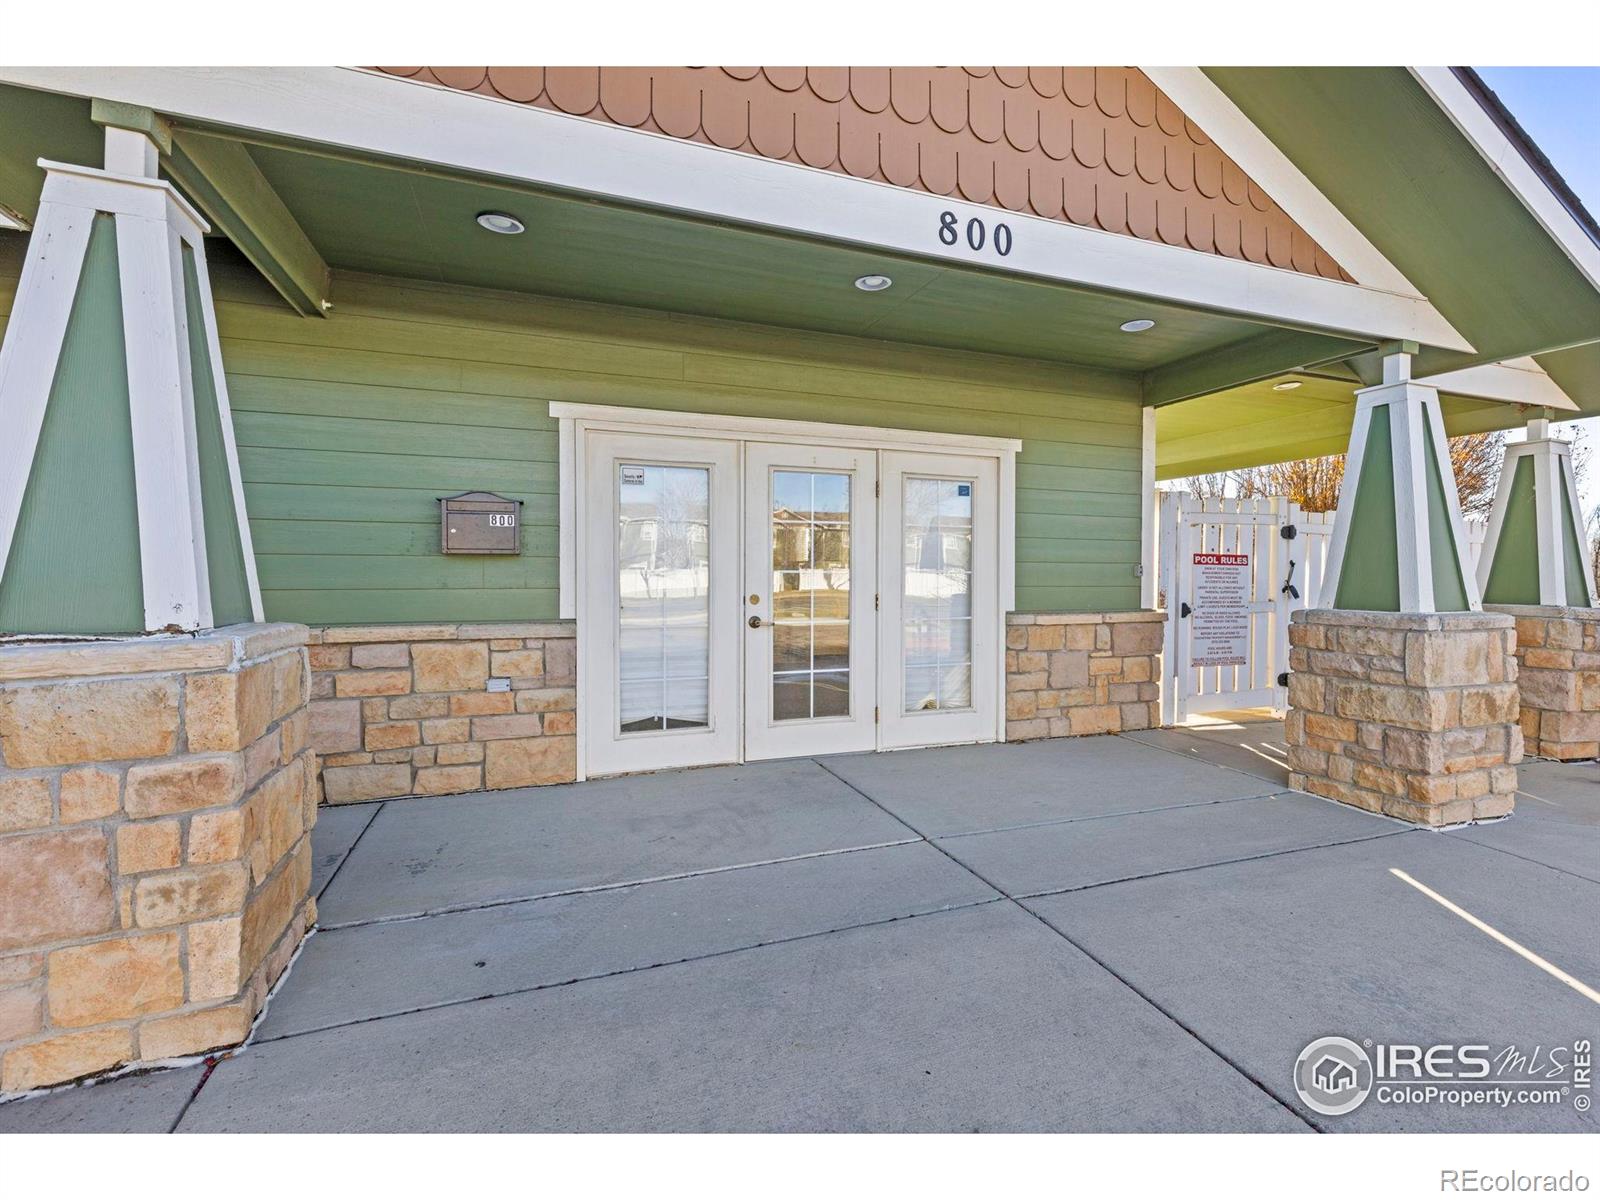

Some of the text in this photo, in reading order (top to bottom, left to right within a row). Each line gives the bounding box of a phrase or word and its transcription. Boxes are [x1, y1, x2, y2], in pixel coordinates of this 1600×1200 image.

[938, 211, 1013, 256] 800
[491, 515, 513, 526] 800
[1194, 556, 1248, 564] POOL RULES
